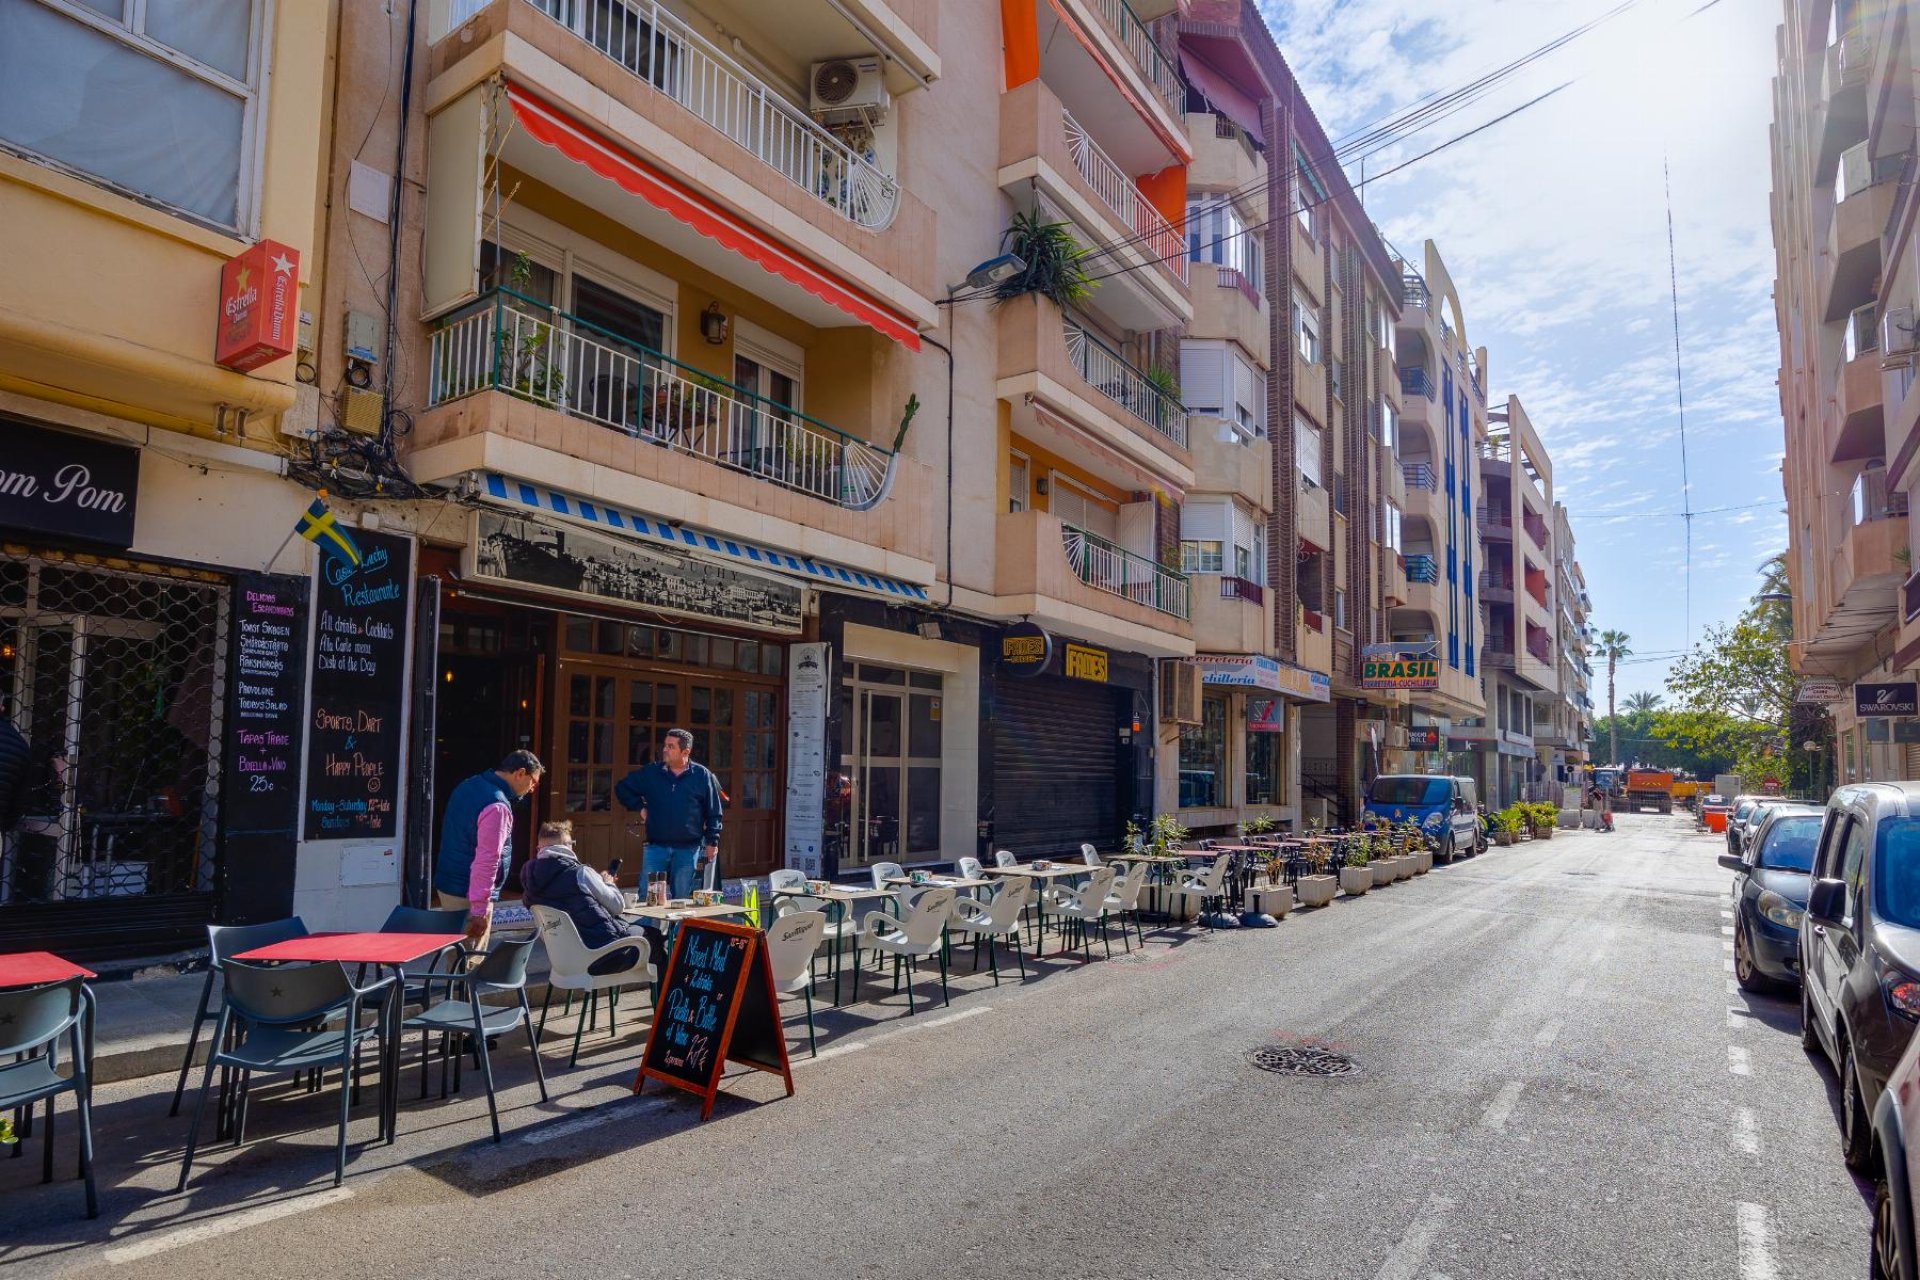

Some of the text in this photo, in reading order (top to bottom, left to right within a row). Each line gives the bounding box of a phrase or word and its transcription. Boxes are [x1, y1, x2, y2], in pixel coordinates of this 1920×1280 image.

[226, 285, 256, 316] Estrella
[272, 276, 287, 340] Estrella Damm
[0, 464, 126, 513] m Pom
[341, 579, 400, 606] Restaurante
[239, 619, 260, 633] TOAST
[320, 610, 333, 631] All
[335, 616, 357, 635] drinks
[365, 616, 394, 639] Cocktails
[360, 657, 377, 676] Day
[1364, 661, 1437, 678] BRASIL
[1859, 703, 1915, 712] SWAROVSKI
[236, 729, 264, 745] TAPAS
[325, 751, 385, 777] HAPPY PEOPLE
